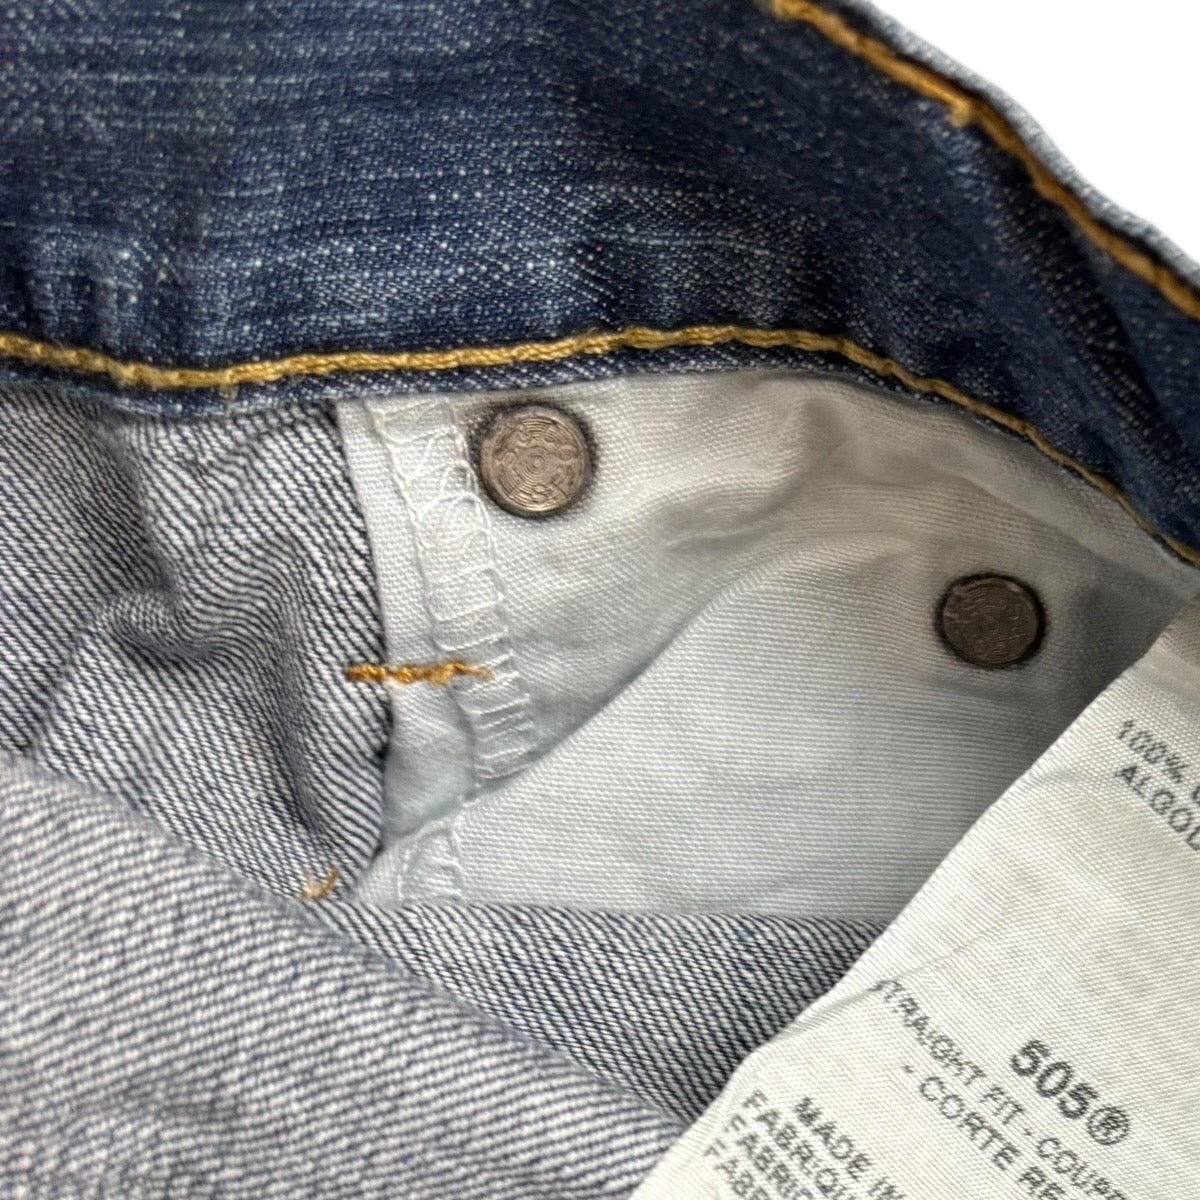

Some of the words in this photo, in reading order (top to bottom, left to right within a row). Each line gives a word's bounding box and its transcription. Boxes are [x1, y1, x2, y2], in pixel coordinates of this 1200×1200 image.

[1116, 719, 1189, 784] 100%
[793, 1094, 874, 1180] MADE
[919, 1076, 1022, 1170] CORTE
[982, 1084, 1025, 1126] FIT
